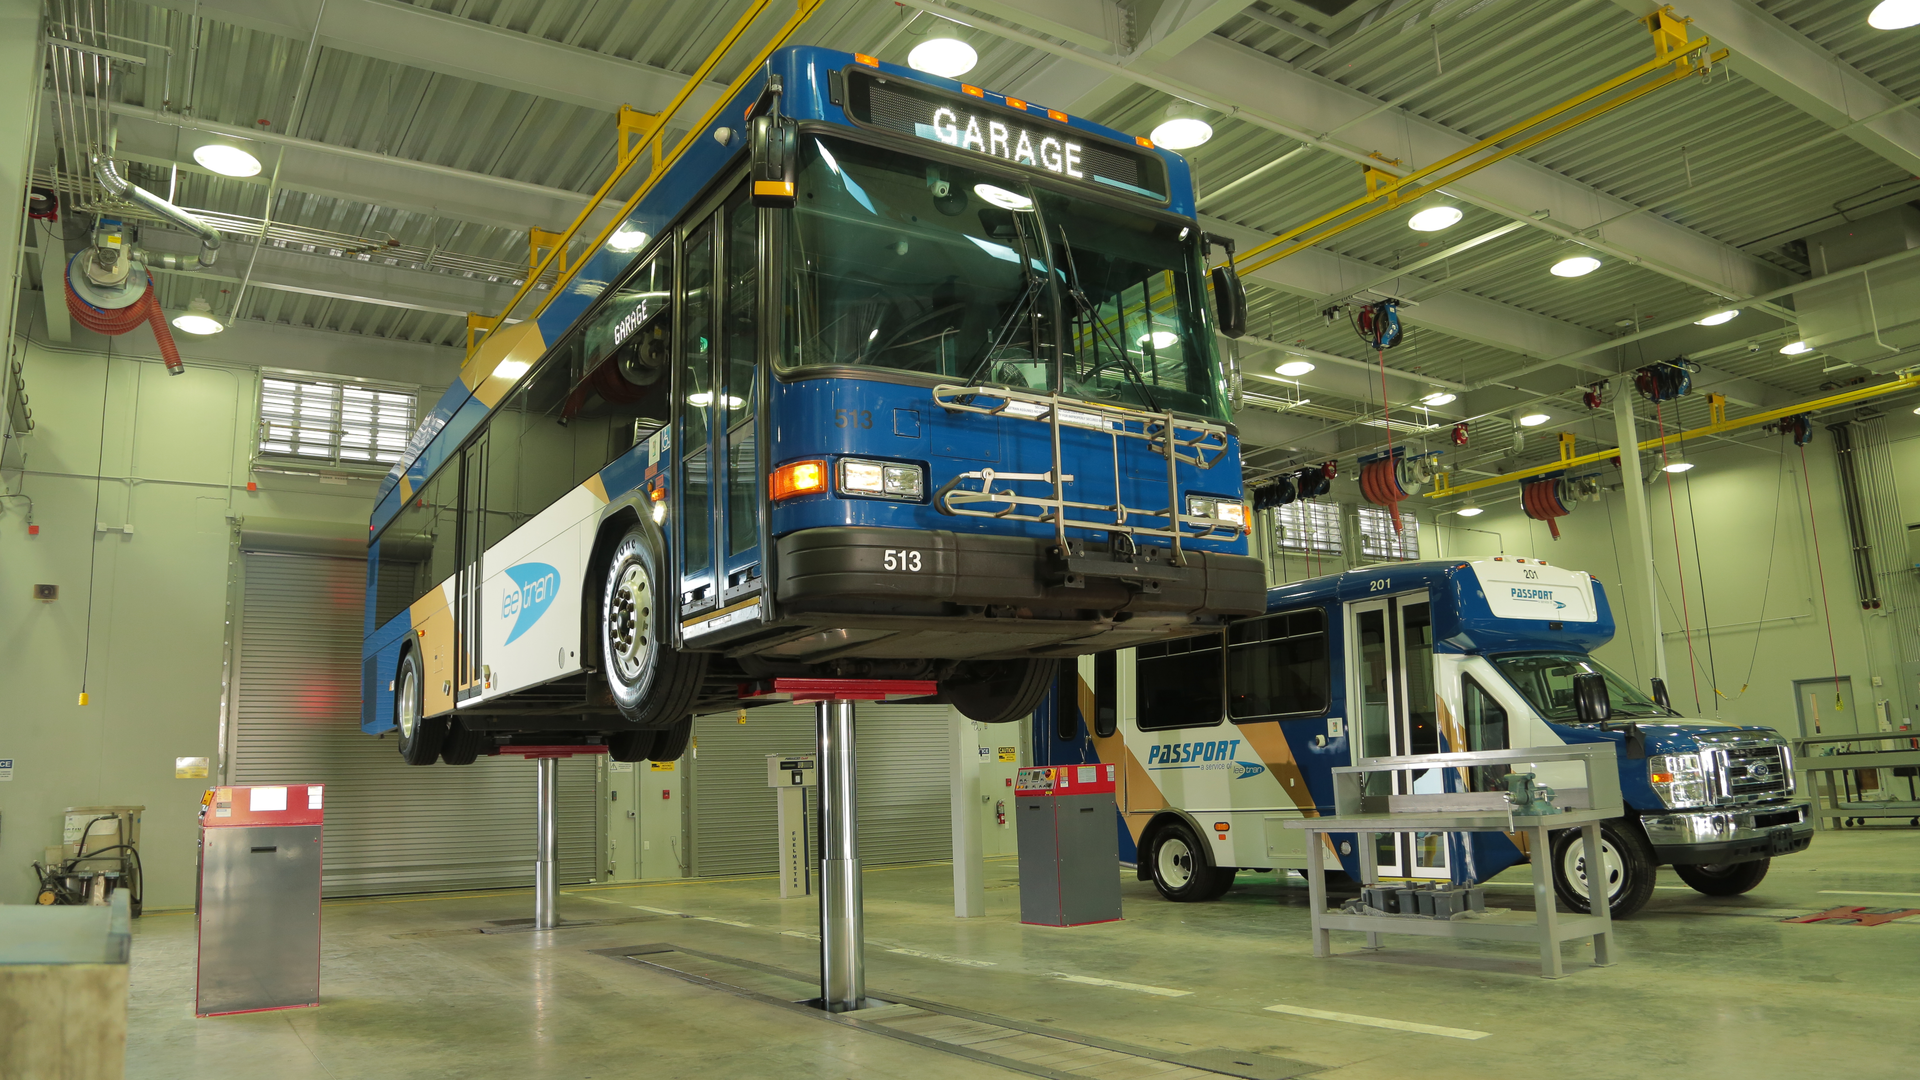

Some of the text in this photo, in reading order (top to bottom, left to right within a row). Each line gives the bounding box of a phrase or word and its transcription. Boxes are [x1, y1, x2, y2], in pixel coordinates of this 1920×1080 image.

[933, 107, 1083, 178] GARAGE
[614, 298, 648, 345] GARAGE
[834, 408, 873, 429] 513
[883, 549, 922, 572] 513
[1369, 577, 1391, 592] 201
[1523, 569, 1539, 579] 201
[1226, 761, 1233, 770] of
